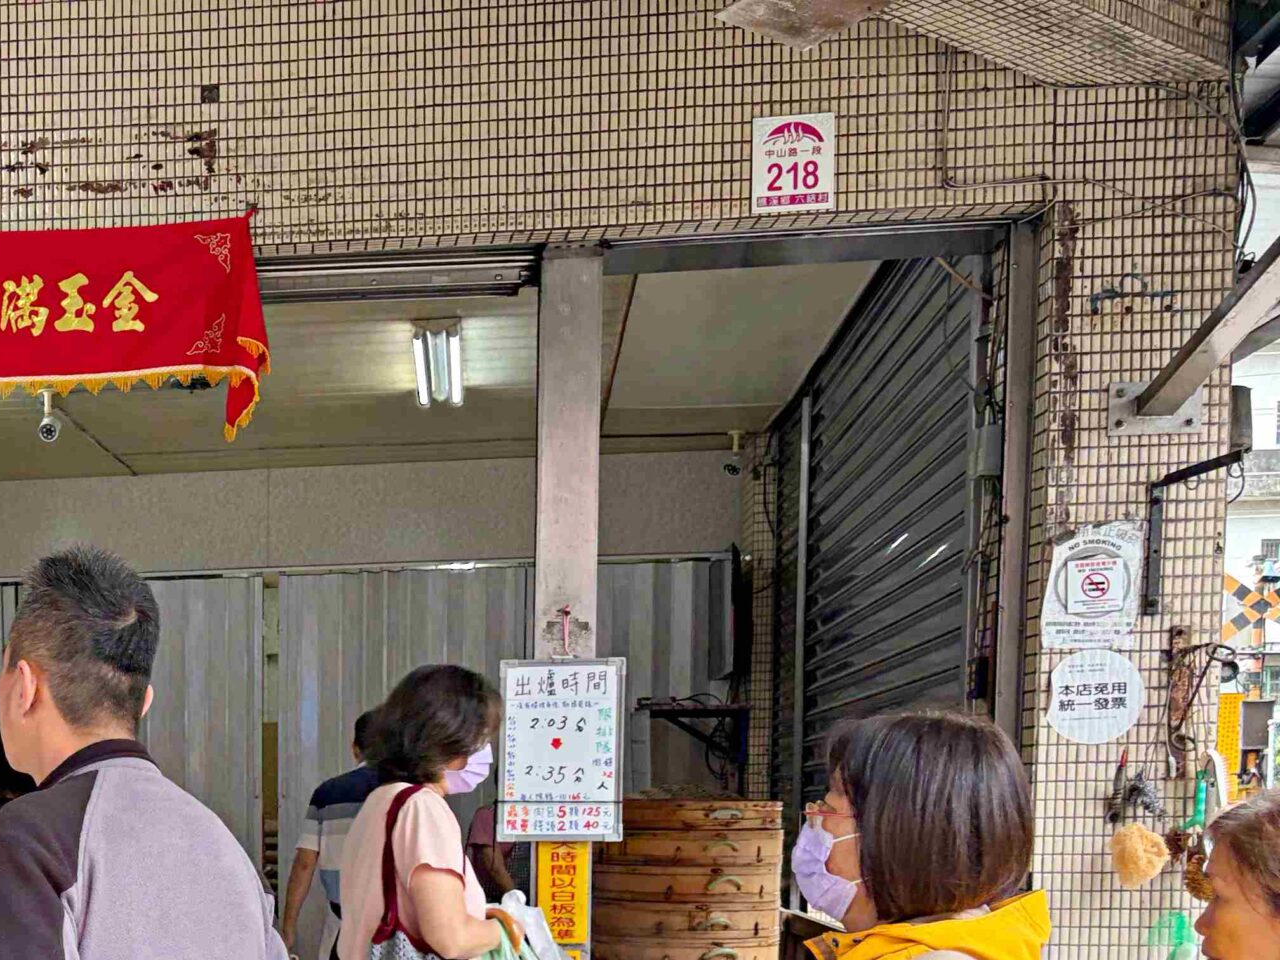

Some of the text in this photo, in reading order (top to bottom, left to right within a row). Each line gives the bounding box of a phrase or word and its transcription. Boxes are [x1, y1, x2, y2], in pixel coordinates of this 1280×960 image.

[764, 145, 822, 159] 中山路一段
[767, 160, 819, 192] 218
[1068, 538, 1123, 552] NO SMOKING
[515, 670, 608, 697] 出爐時間
[1058, 682, 1127, 697] 本店免用
[1058, 697, 1127, 712] 統一發票
